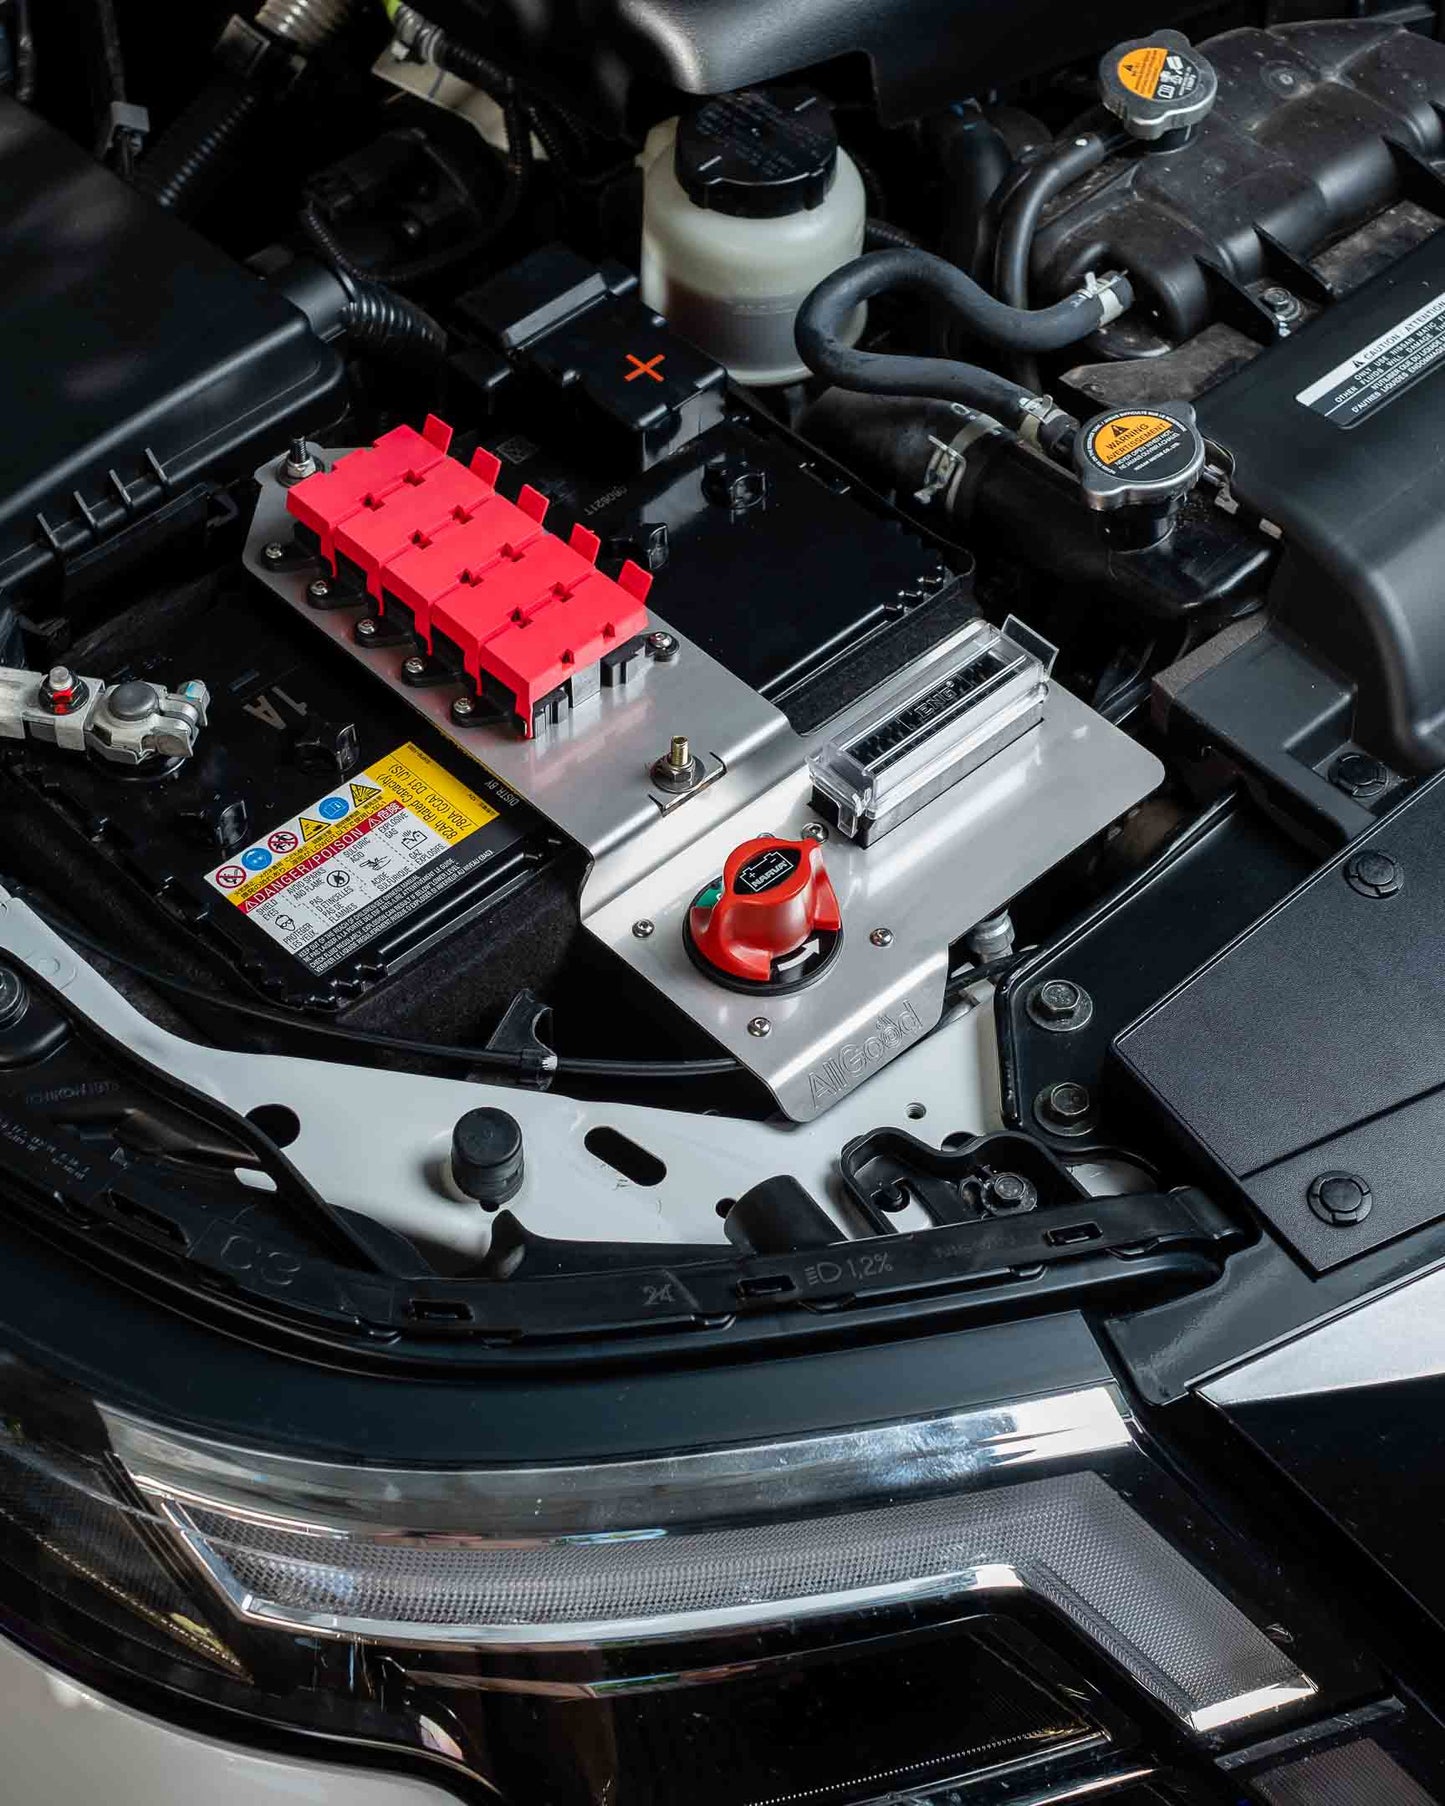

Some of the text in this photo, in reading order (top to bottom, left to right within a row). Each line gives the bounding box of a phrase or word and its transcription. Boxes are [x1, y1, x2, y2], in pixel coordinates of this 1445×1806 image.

[1353, 366, 1374, 381] ONLY
[1372, 355, 1390, 367] USE
[1389, 336, 1416, 356] NISSAN
[1414, 321, 1438, 338] MATIC
[1362, 333, 1401, 361] CAUTION
[1398, 359, 1414, 371] QUE
[1410, 353, 1423, 363] DU
[1418, 339, 1443, 357] LIQUIDE
[1333, 385, 1359, 404] OTHER
[1359, 367, 1385, 386] FLUIDS
[1385, 353, 1405, 367] WILL
[1405, 332, 1434, 353] DAMAGE
[1379, 371, 1410, 393] LIQUIDES
[1105, 422, 1167, 462] AVERTISSEMENT
[1106, 422, 1149, 451] WARNING
[1130, 445, 1147, 457] OPEN
[242, 686, 306, 727] 1A
[483, 778, 500, 790] BY
[375, 771, 459, 841] 82Ah (Rated Capacity)
[387, 762, 472, 832] 780A (CCA) D31 (JIS)
[376, 802, 402, 821] 危険
[377, 811, 410, 834] EXPLOSIVE
[384, 828, 399, 839] GAS
[342, 837, 372, 858] SULFURIC
[348, 851, 366, 864] ACID
[408, 849, 423, 860] GAZ
[253, 827, 364, 904] DANGER/POISON
[751, 862, 787, 887] NARVA
[286, 866, 327, 895] AVOID SPARKS
[292, 877, 325, 901] AND FLAME
[370, 871, 391, 887] ACIDE
[376, 866, 413, 892] SULFURIQUE
[255, 898, 279, 916] SHIELD
[309, 895, 324, 907] PAS
[322, 902, 344, 918] PAS DE
[262, 907, 280, 921] EYES
[328, 902, 359, 924] FLAMMES
[282, 922, 314, 945] PROTEGER
[289, 939, 304, 951] LES
[809, 1000, 924, 1112] AllGood
[843, 1251, 893, 1281] 1,2%
